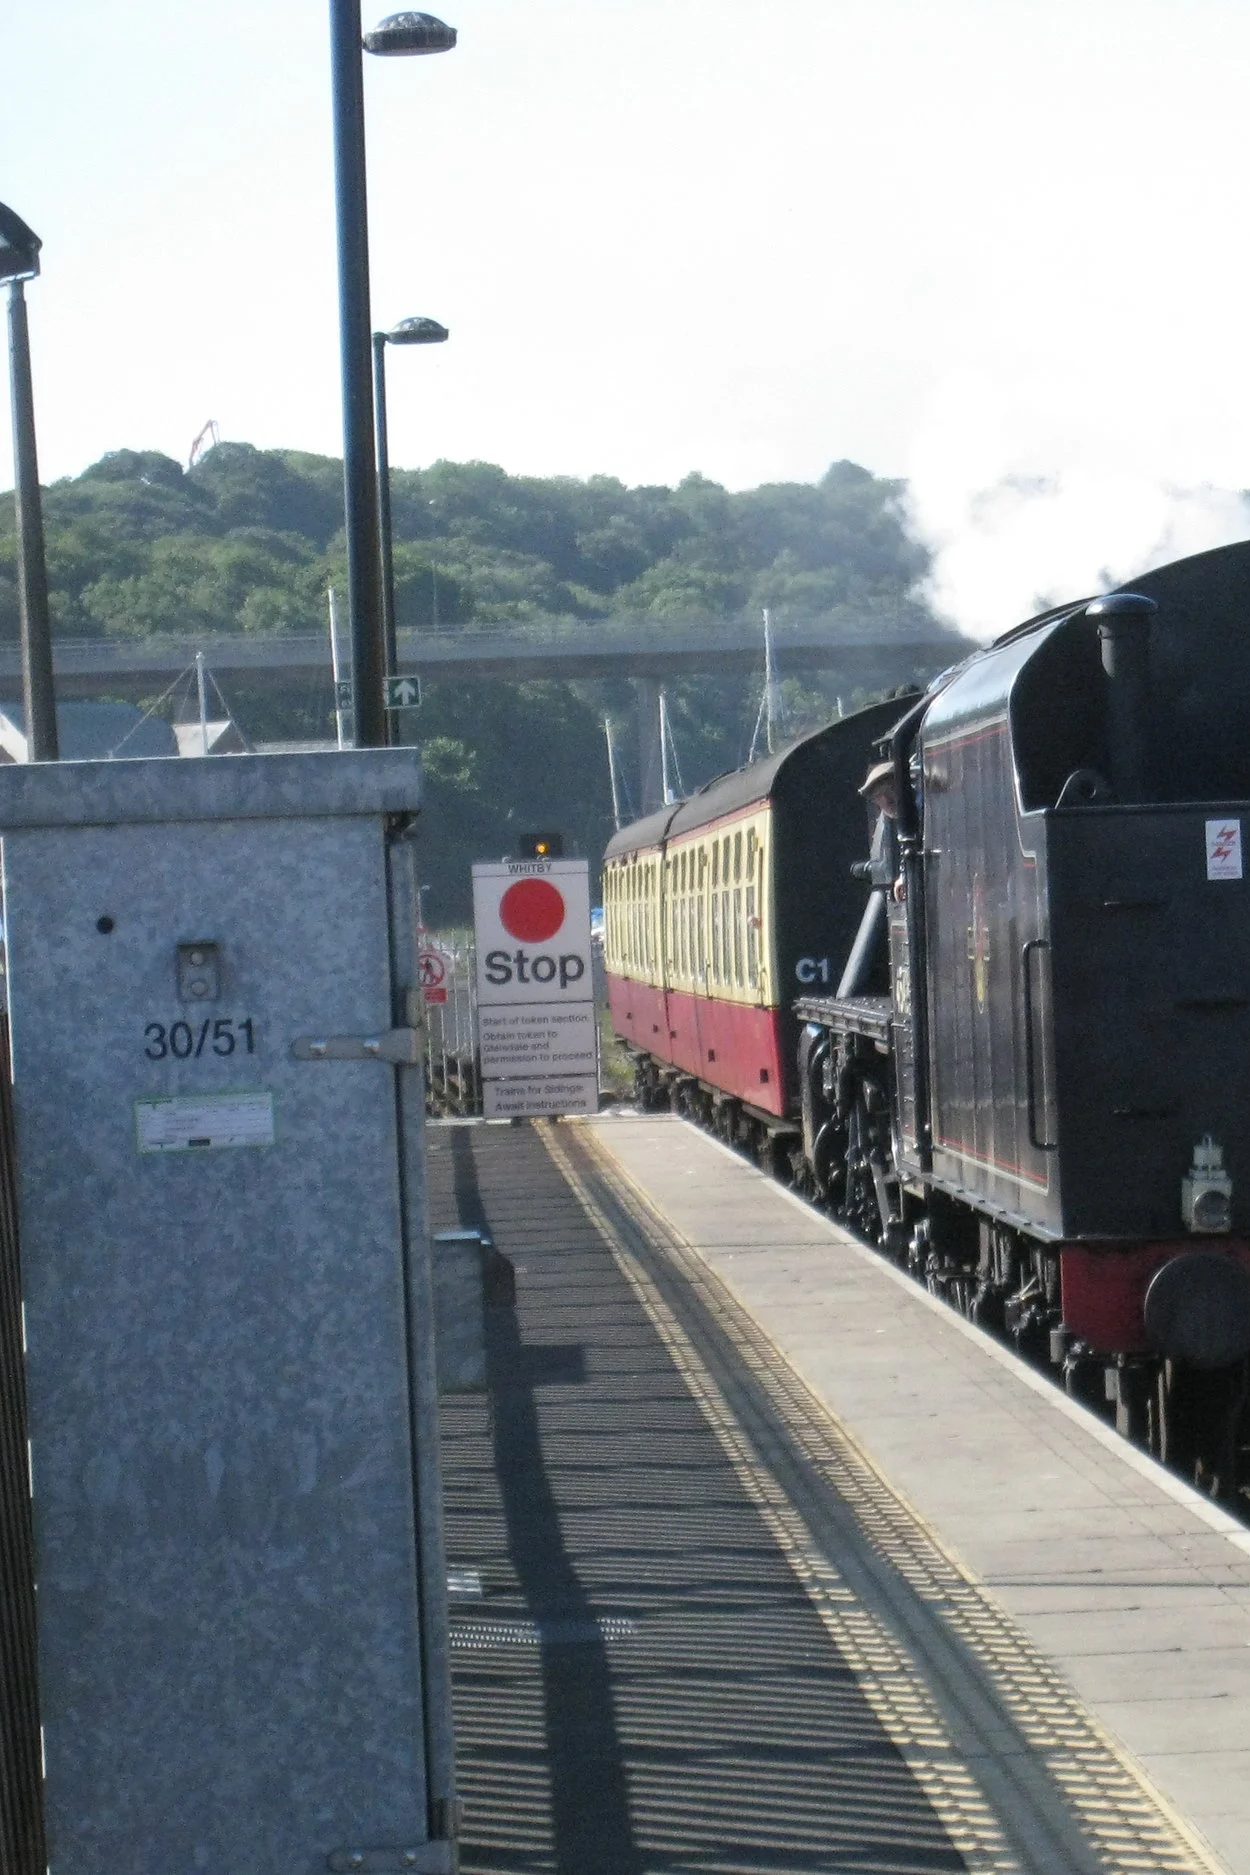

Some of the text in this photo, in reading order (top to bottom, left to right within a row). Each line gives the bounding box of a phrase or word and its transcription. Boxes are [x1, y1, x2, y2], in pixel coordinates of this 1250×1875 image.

[508, 863, 552, 874] WHITBY
[485, 949, 585, 990] Stop
[795, 957, 828, 983] C1
[482, 1016, 507, 1027] Start
[509, 1016, 519, 1025] of
[521, 1015, 549, 1025] token
[144, 1017, 255, 1061] 30/51
[483, 1030, 558, 1041] Obtain token to
[531, 1041, 550, 1051] and
[483, 1051, 593, 1065] permission to proceed
[527, 1085, 541, 1095] for
[495, 1101, 525, 1112] Await
